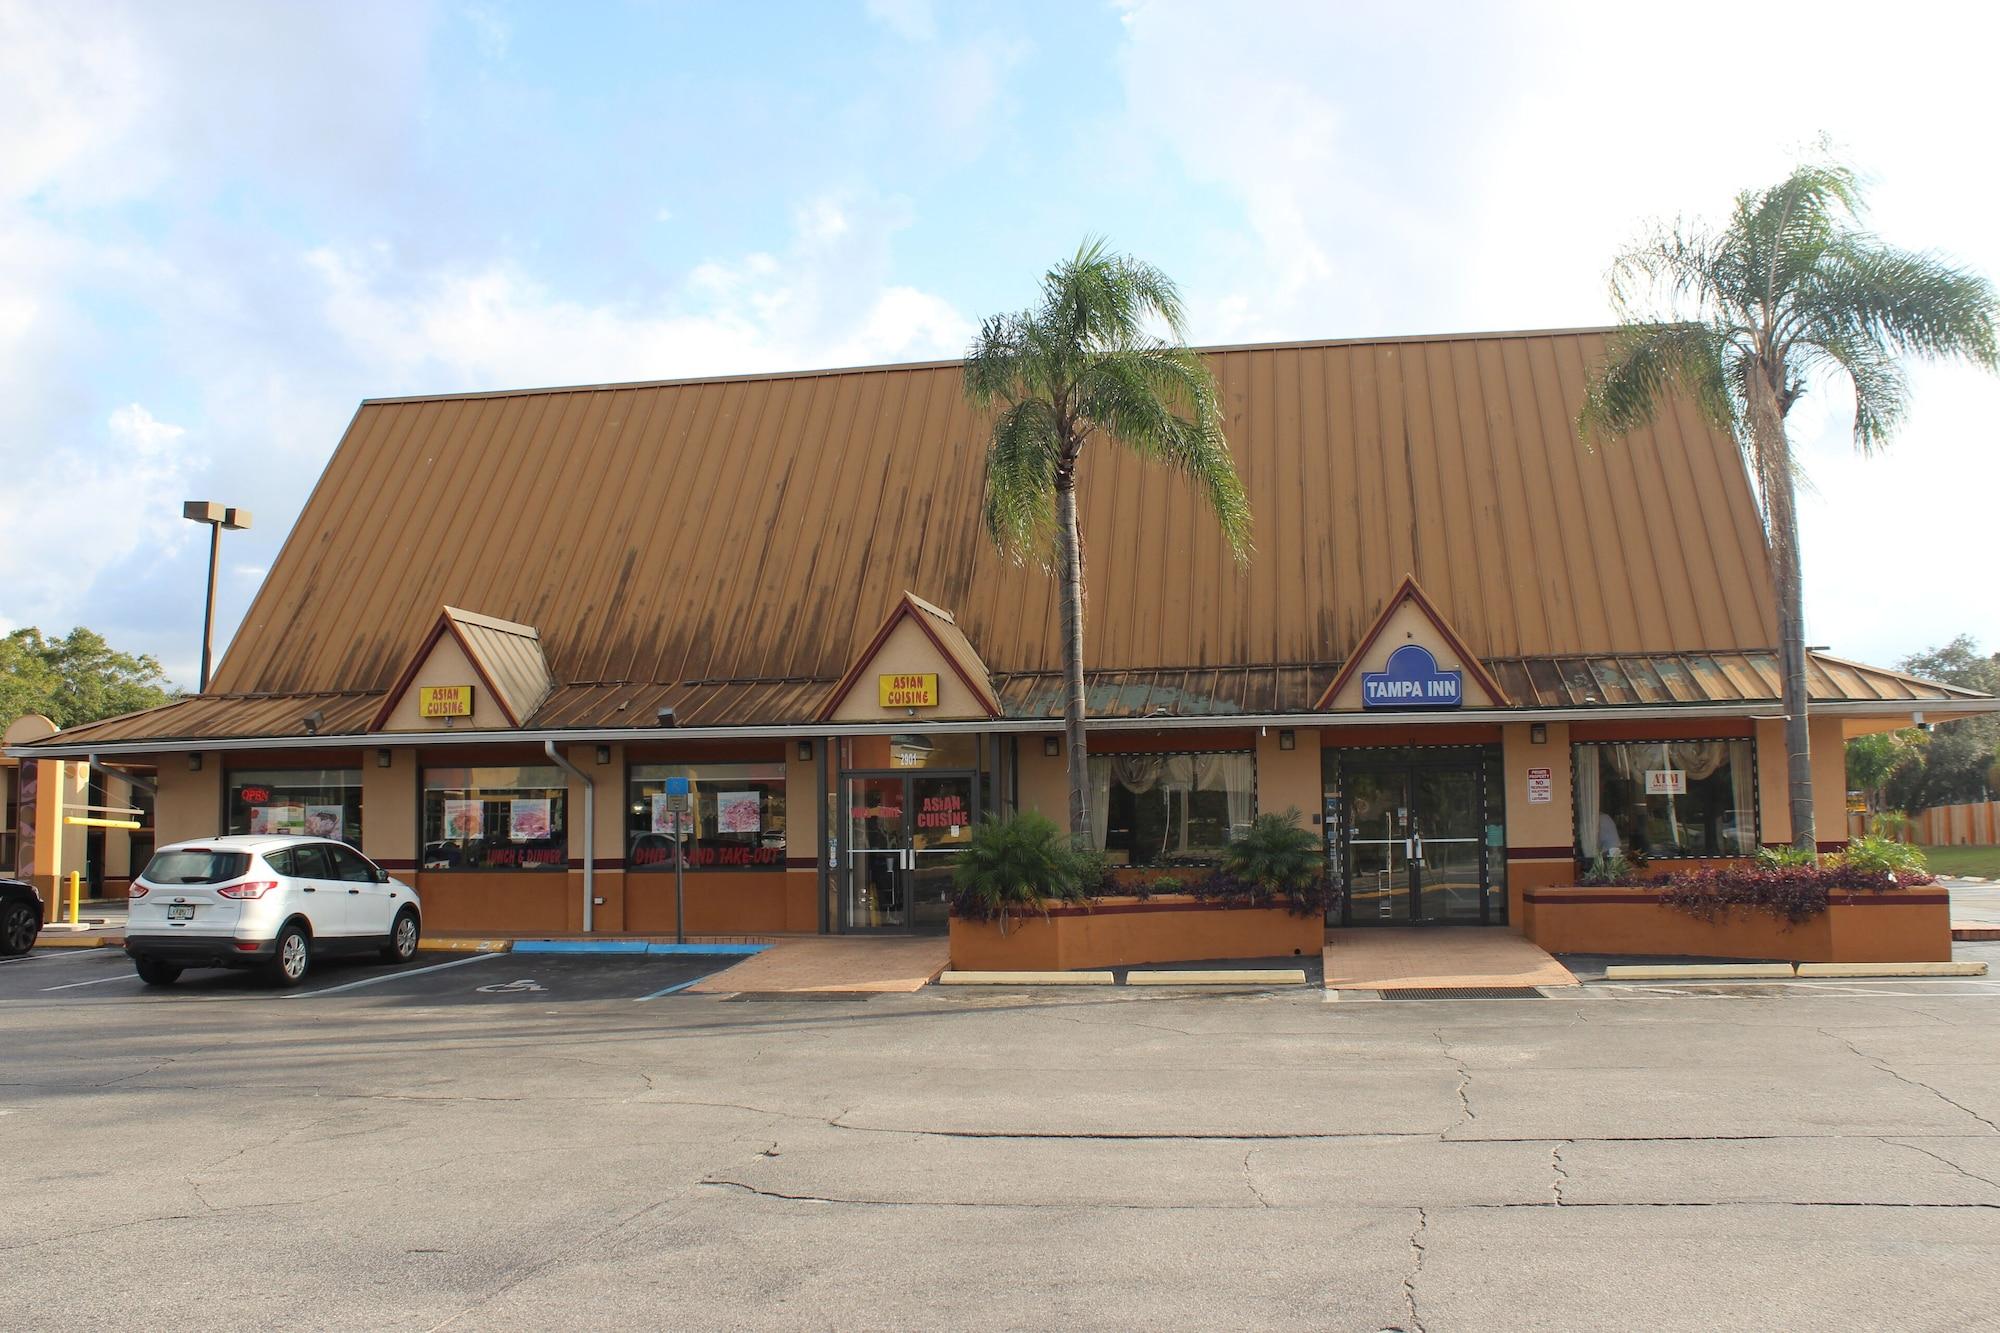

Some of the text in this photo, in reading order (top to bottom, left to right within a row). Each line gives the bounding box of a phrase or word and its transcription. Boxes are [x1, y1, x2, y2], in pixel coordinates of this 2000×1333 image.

[893, 676, 923, 689] ASIAN
[1367, 680, 1456, 698] TAMPA INN
[432, 688, 459, 700] ASIAN
[888, 691, 929, 704] CUISINE
[427, 701, 464, 714] CUISINE
[900, 753, 917, 765] 2901
[242, 788, 269, 801] OPEN
[922, 796, 961, 811] ASIAN
[917, 811, 968, 828] CUISINE
[487, 848, 515, 864] LUNCH
[526, 848, 561, 864] DINNER
[635, 848, 666, 864] DINE
[688, 848, 714, 864] AND
